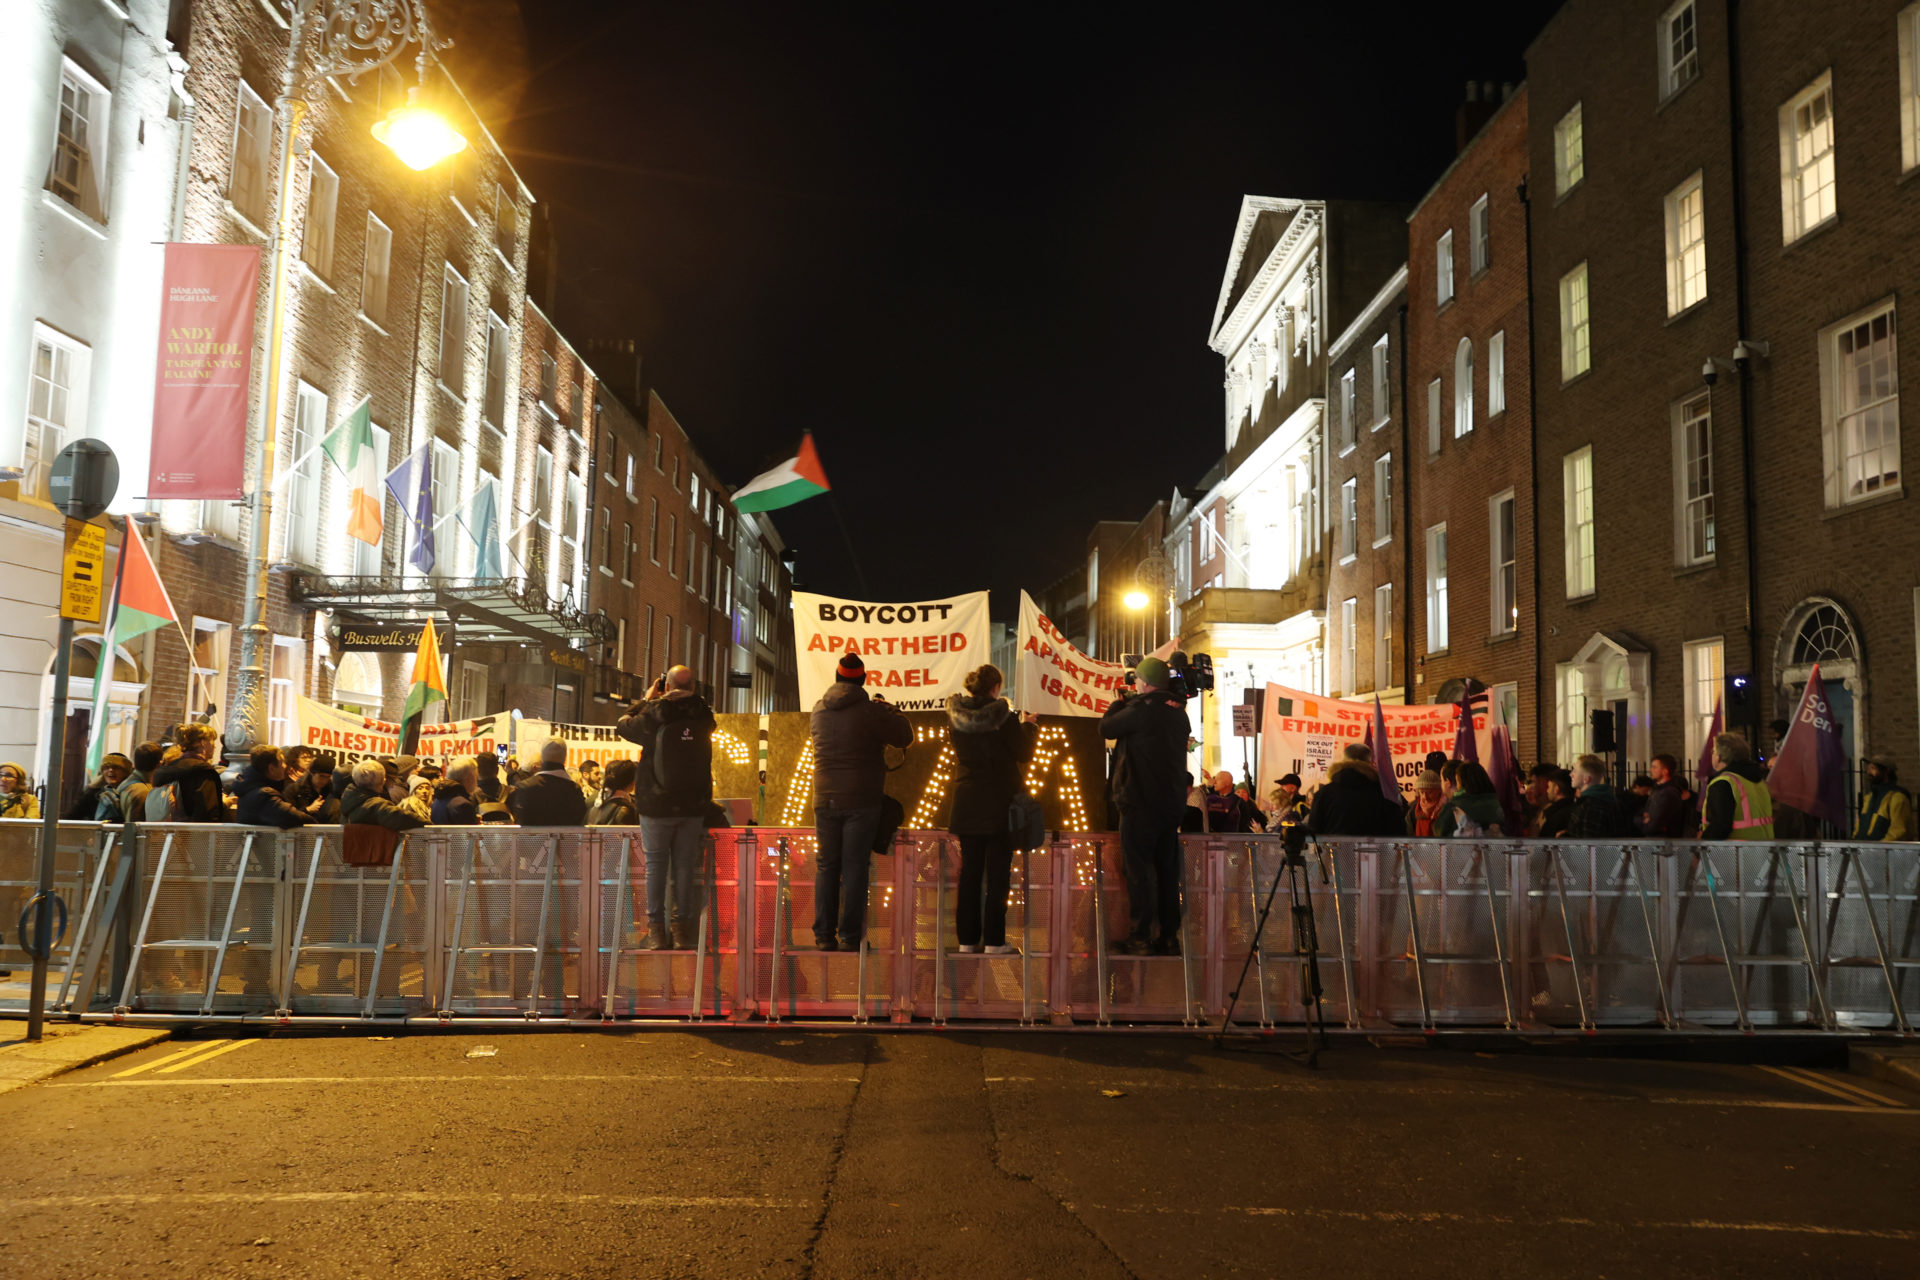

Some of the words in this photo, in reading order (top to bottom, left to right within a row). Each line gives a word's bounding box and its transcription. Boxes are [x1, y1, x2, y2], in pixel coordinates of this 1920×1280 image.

[168, 327, 215, 340] ANDY
[167, 342, 243, 355] WARHOL
[819, 604, 953, 624] BOYCOTT
[344, 631, 405, 646] Buswells
[807, 632, 967, 655] APARTHEID
[865, 668, 938, 687] RAEL
[1041, 674, 1110, 714] ISRAE
[1398, 709, 1440, 722] THE
[550, 722, 589, 741] FREE
[593, 727, 622, 742] ALL
[1282, 718, 1361, 737] ETHNIC
[440, 738, 494, 756] CHILD
